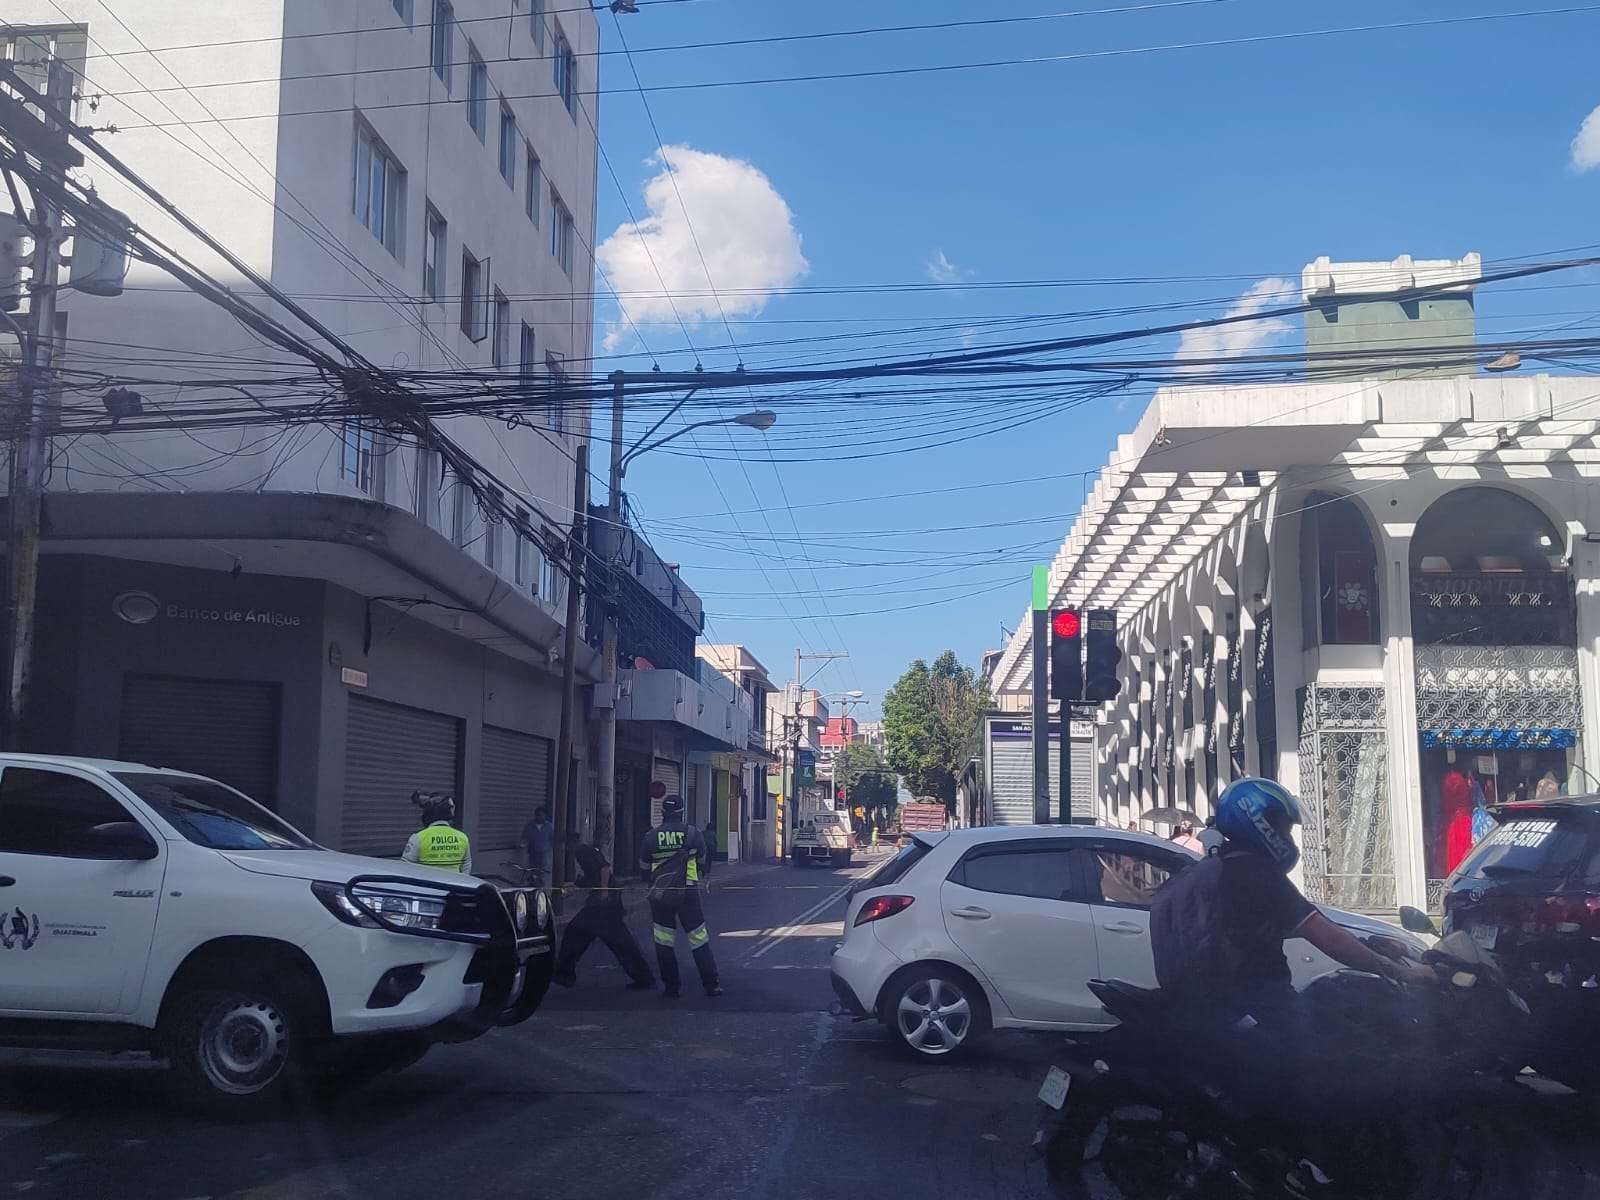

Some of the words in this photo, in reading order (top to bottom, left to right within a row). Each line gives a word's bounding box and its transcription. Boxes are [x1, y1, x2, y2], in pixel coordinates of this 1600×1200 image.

[166, 604, 220, 621] Banco
[224, 608, 242, 622] de
[245, 609, 301, 627] Antigua
[657, 831, 685, 846] PMT
[52, 928, 98, 937] GUATEMALA
